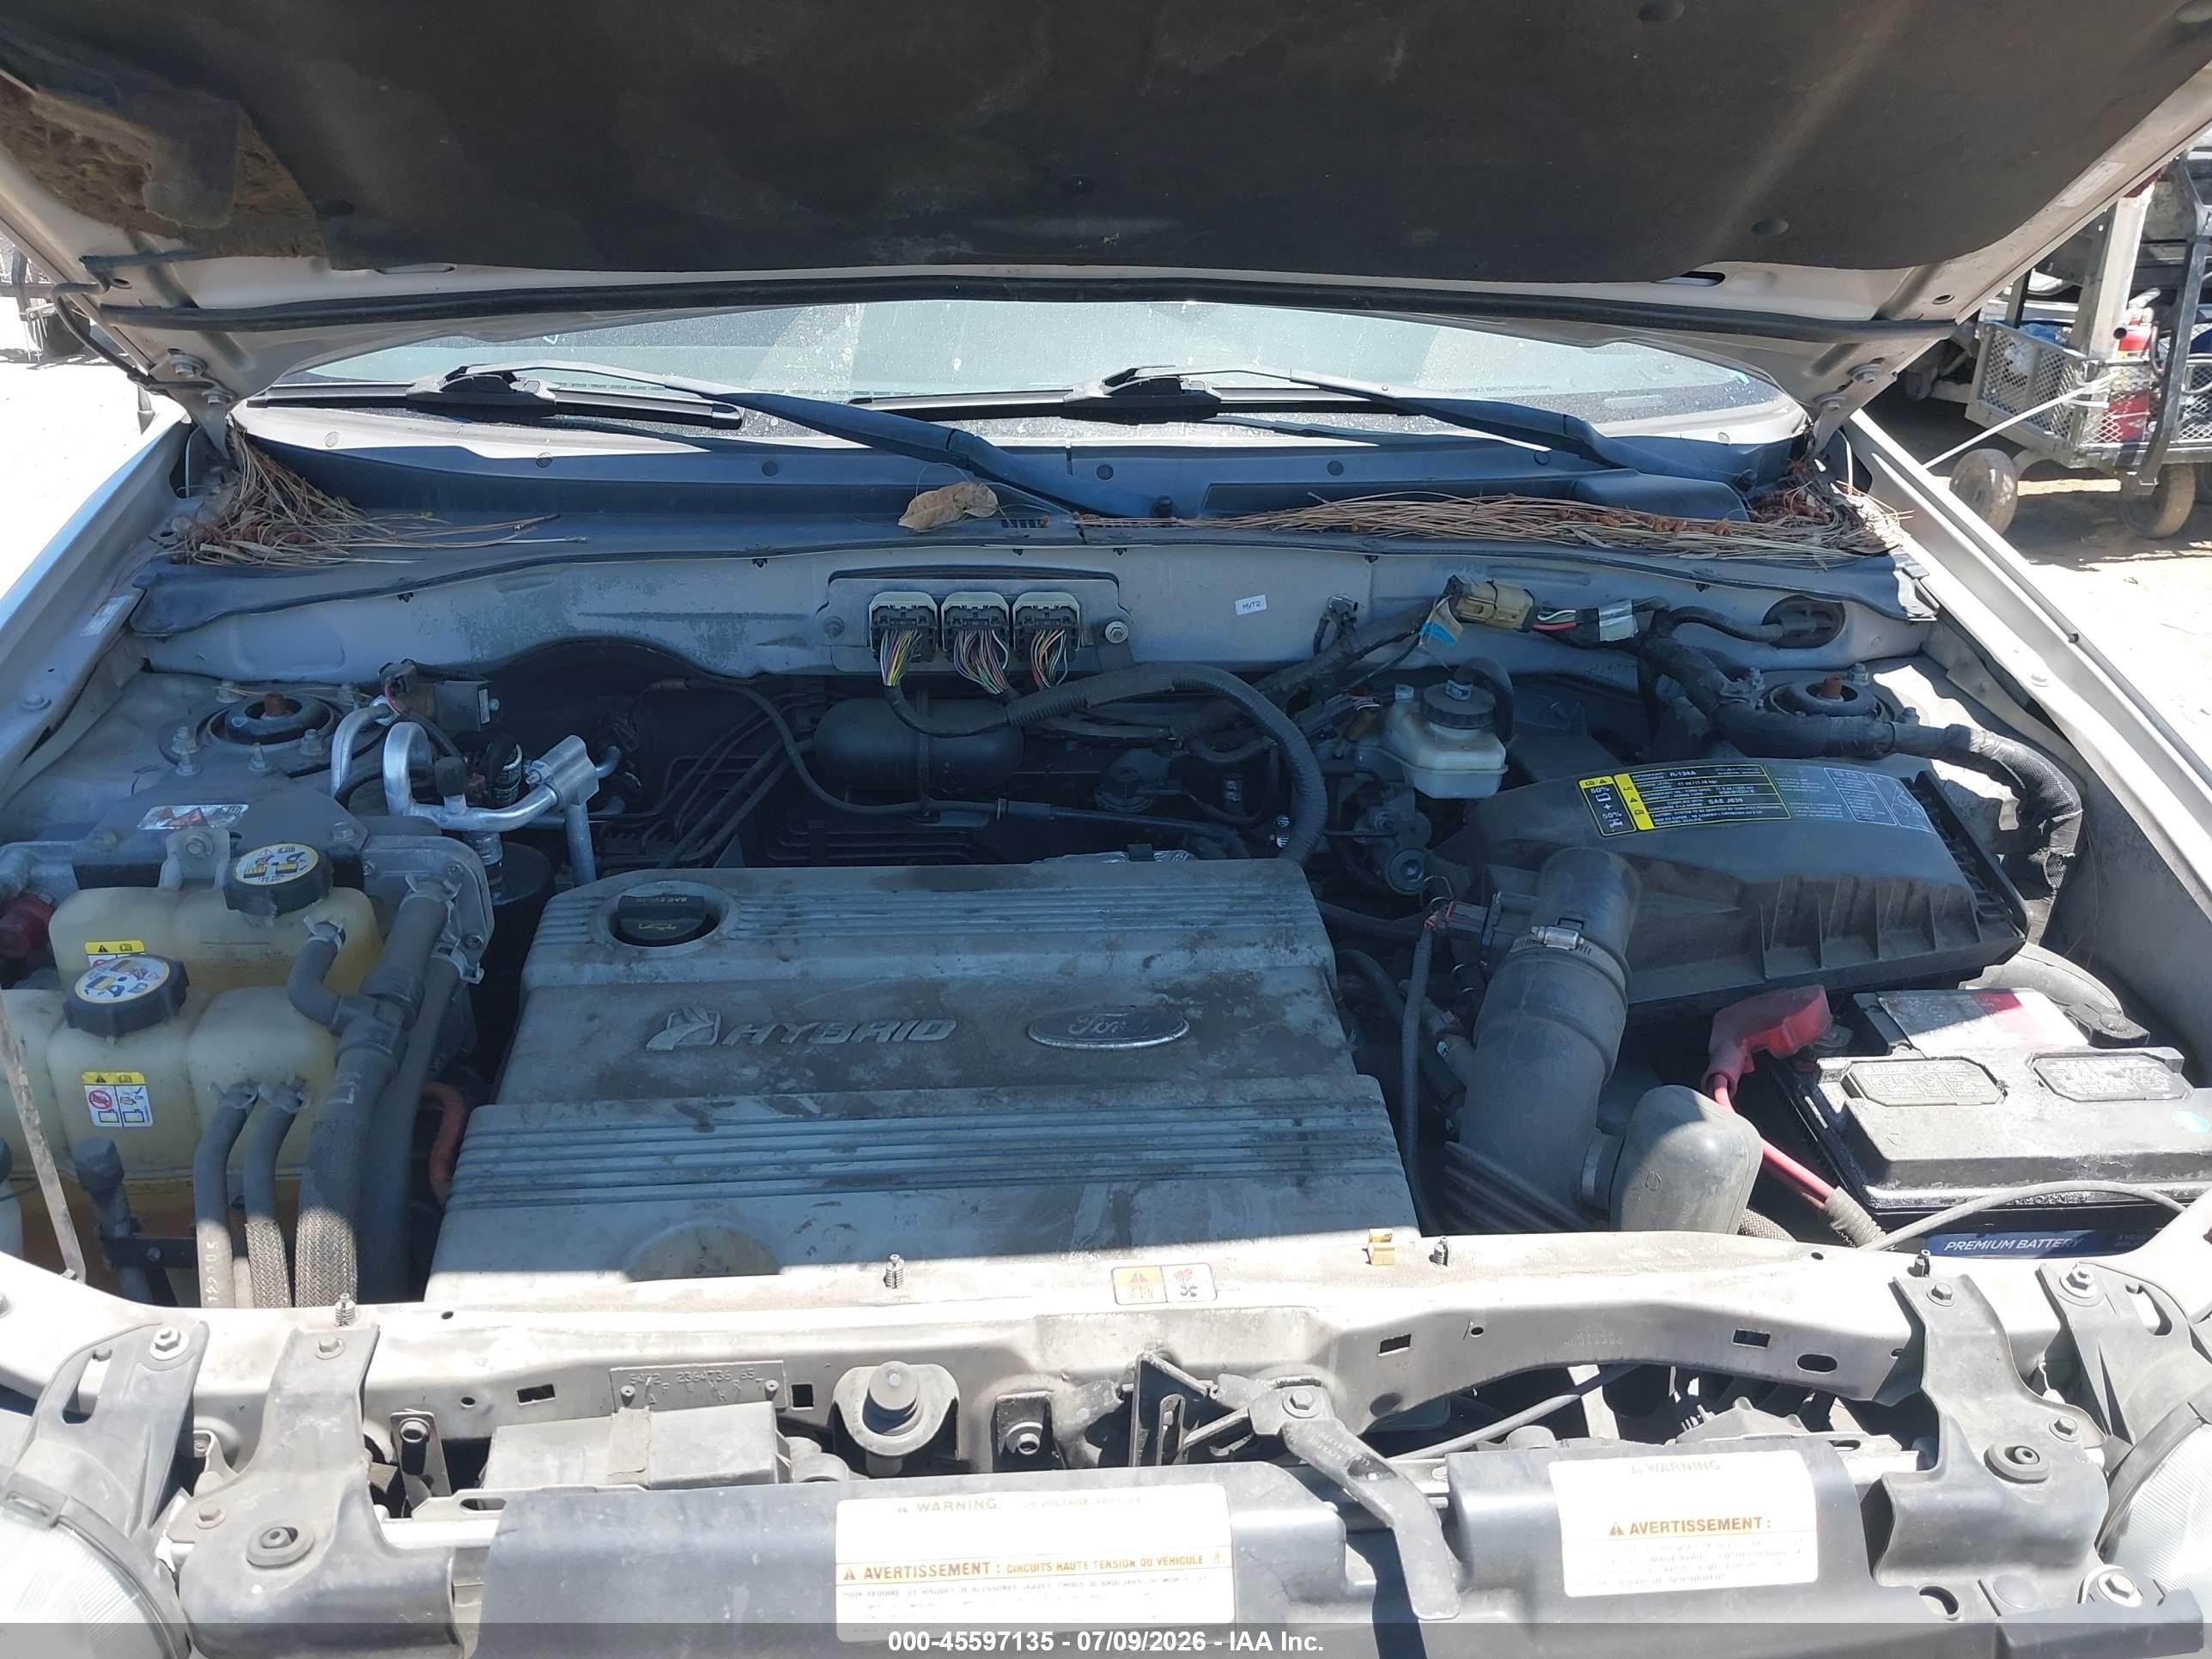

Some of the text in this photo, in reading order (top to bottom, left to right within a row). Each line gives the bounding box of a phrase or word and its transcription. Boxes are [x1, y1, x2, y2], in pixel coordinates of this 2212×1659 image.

[1590, 786, 1610, 794] 50%
[722, 1018, 957, 1045] HYBRID
[1943, 1237, 2084, 1251] PREMIUM BATTERY
[1629, 1516, 1763, 1535] AVERTISSEMENT
[863, 1561, 991, 1580] AVERTISSEMENT
[1006, 1561, 1053, 1574] CIRCUITS
[1056, 1560, 1089, 1572] HAUTE
[1092, 1559, 1135, 1571] TENSION
[1140, 1557, 1153, 1567] DU
